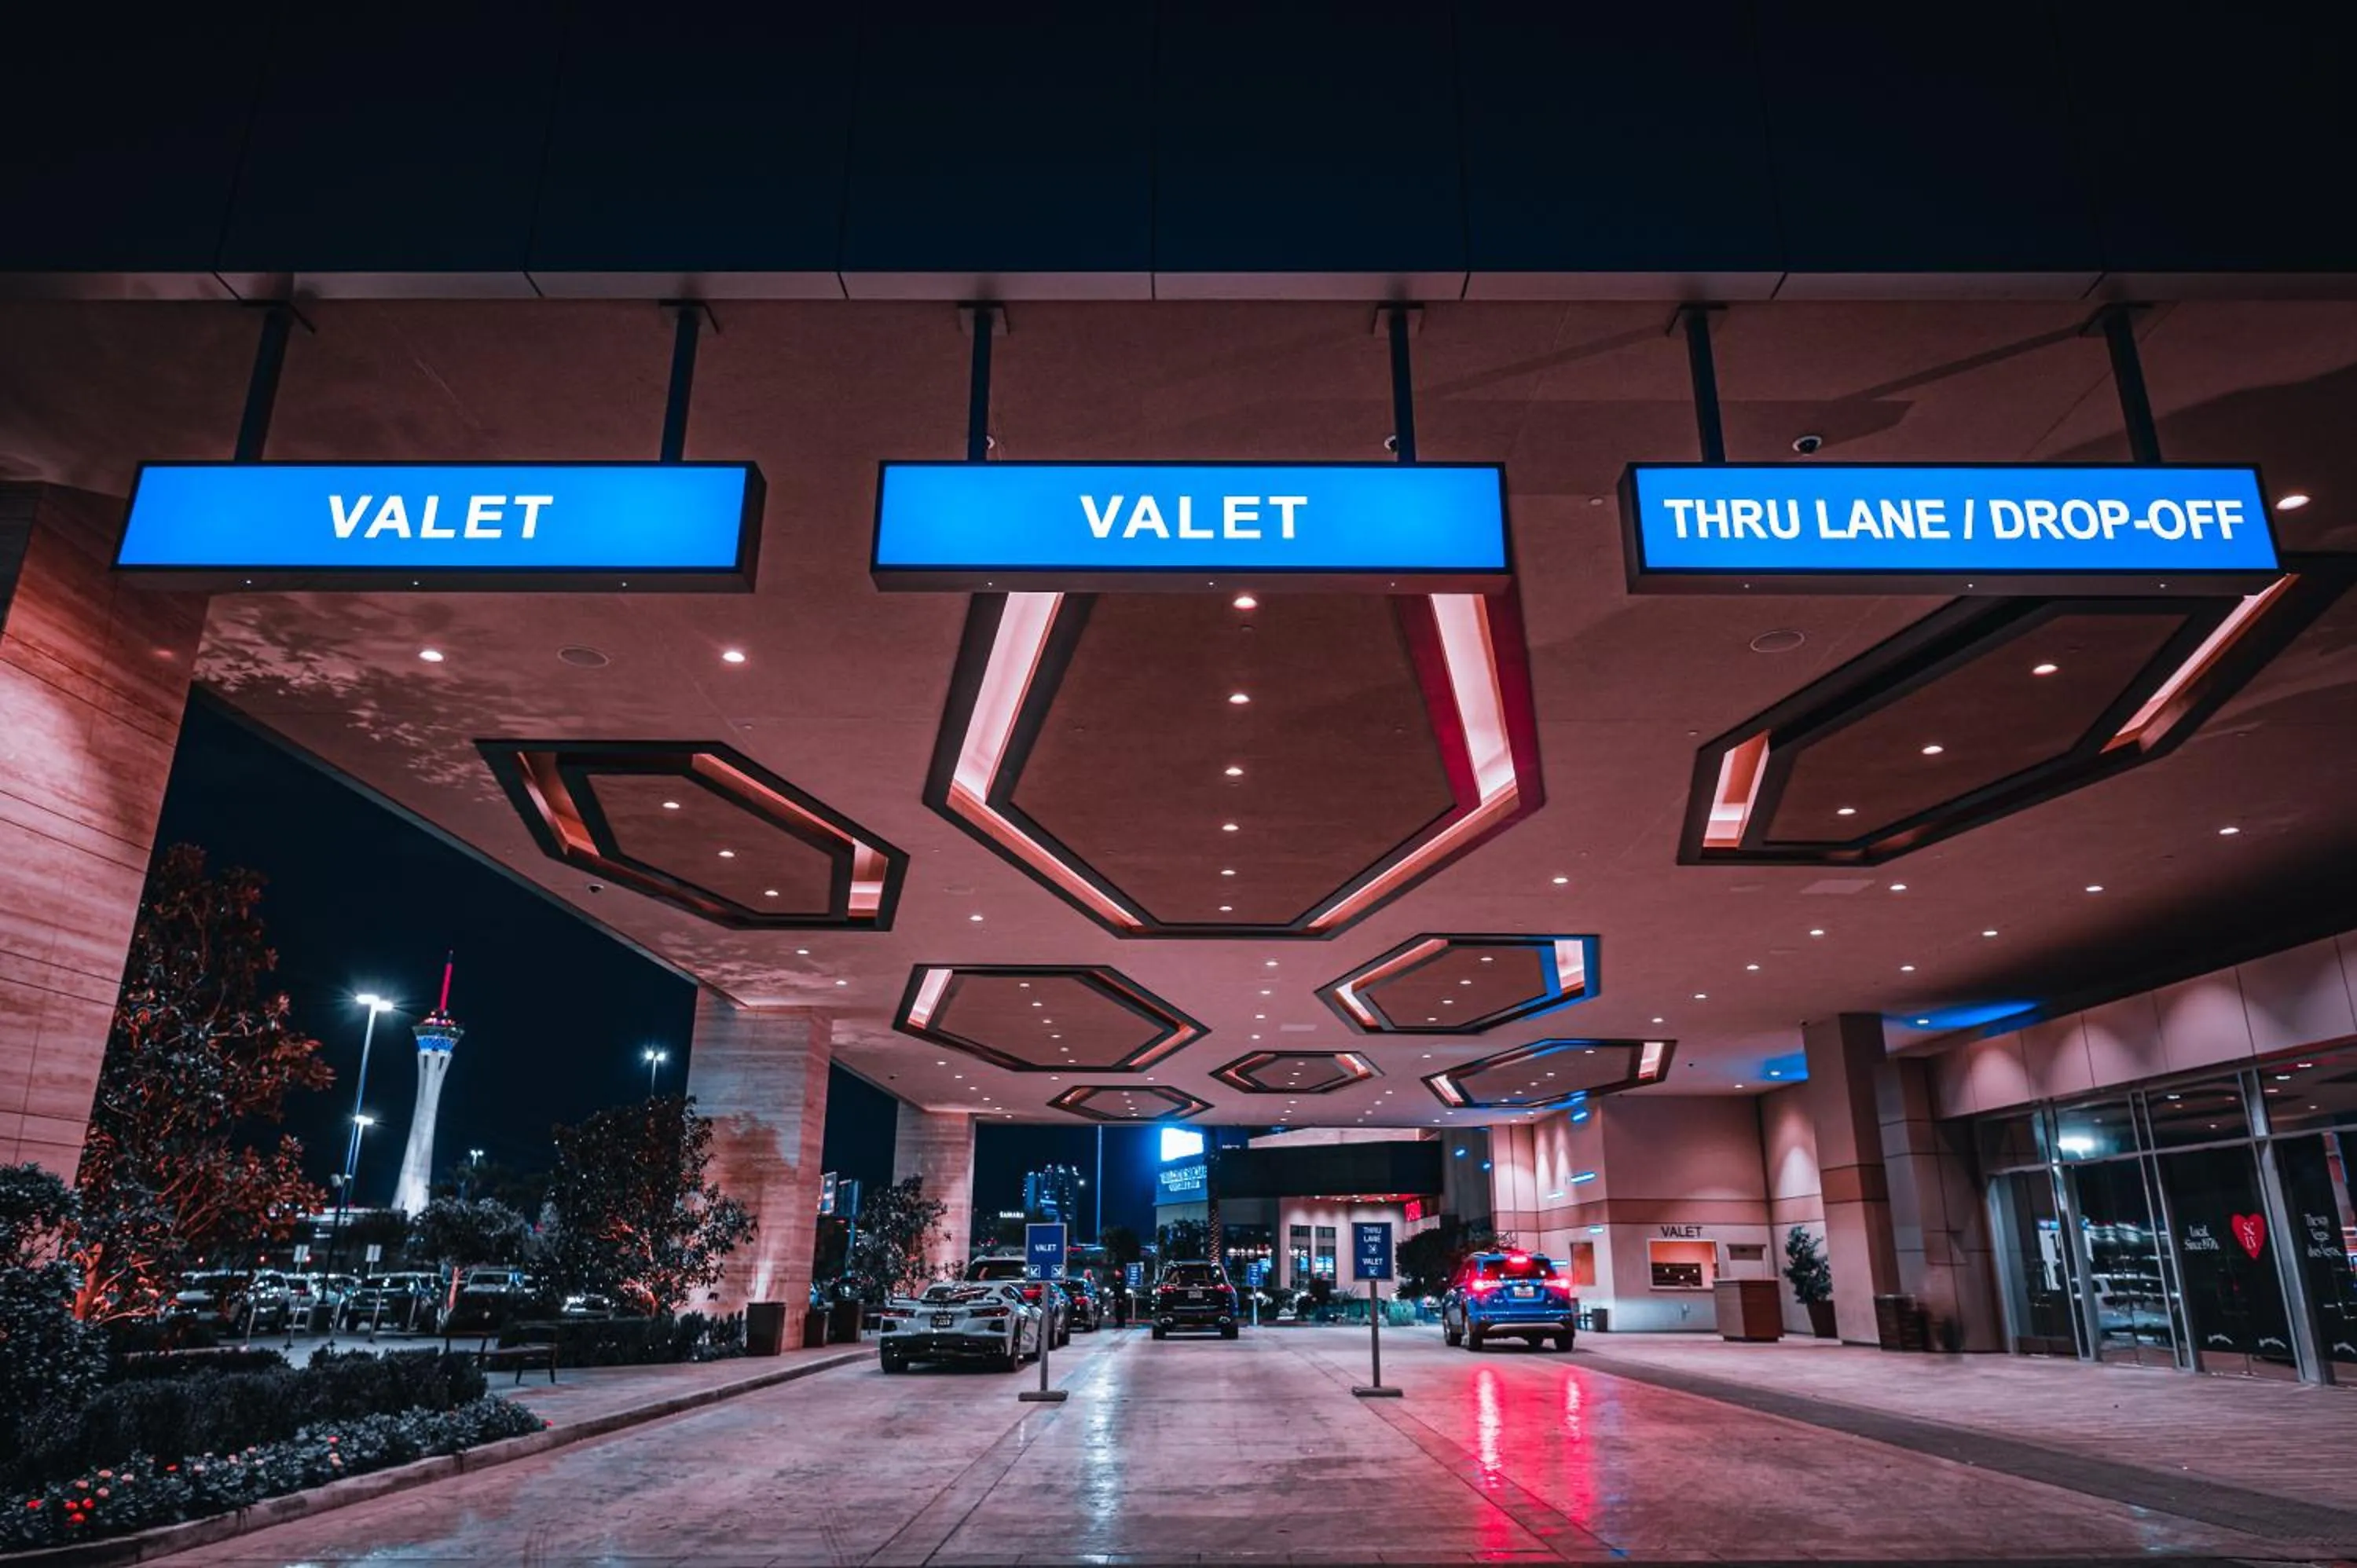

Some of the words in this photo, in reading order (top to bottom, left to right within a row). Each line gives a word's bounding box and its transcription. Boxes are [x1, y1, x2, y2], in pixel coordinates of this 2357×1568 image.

[329, 495, 554, 539] VALET
[1080, 495, 1308, 539] VALET
[1663, 499, 1800, 540] THRU
[1816, 499, 1951, 540] LANE
[1963, 499, 1974, 540] /
[1989, 499, 2244, 540] DROP-OFF
[1363, 1235, 1381, 1244] LANE
[1660, 1225, 1703, 1238] VALET
